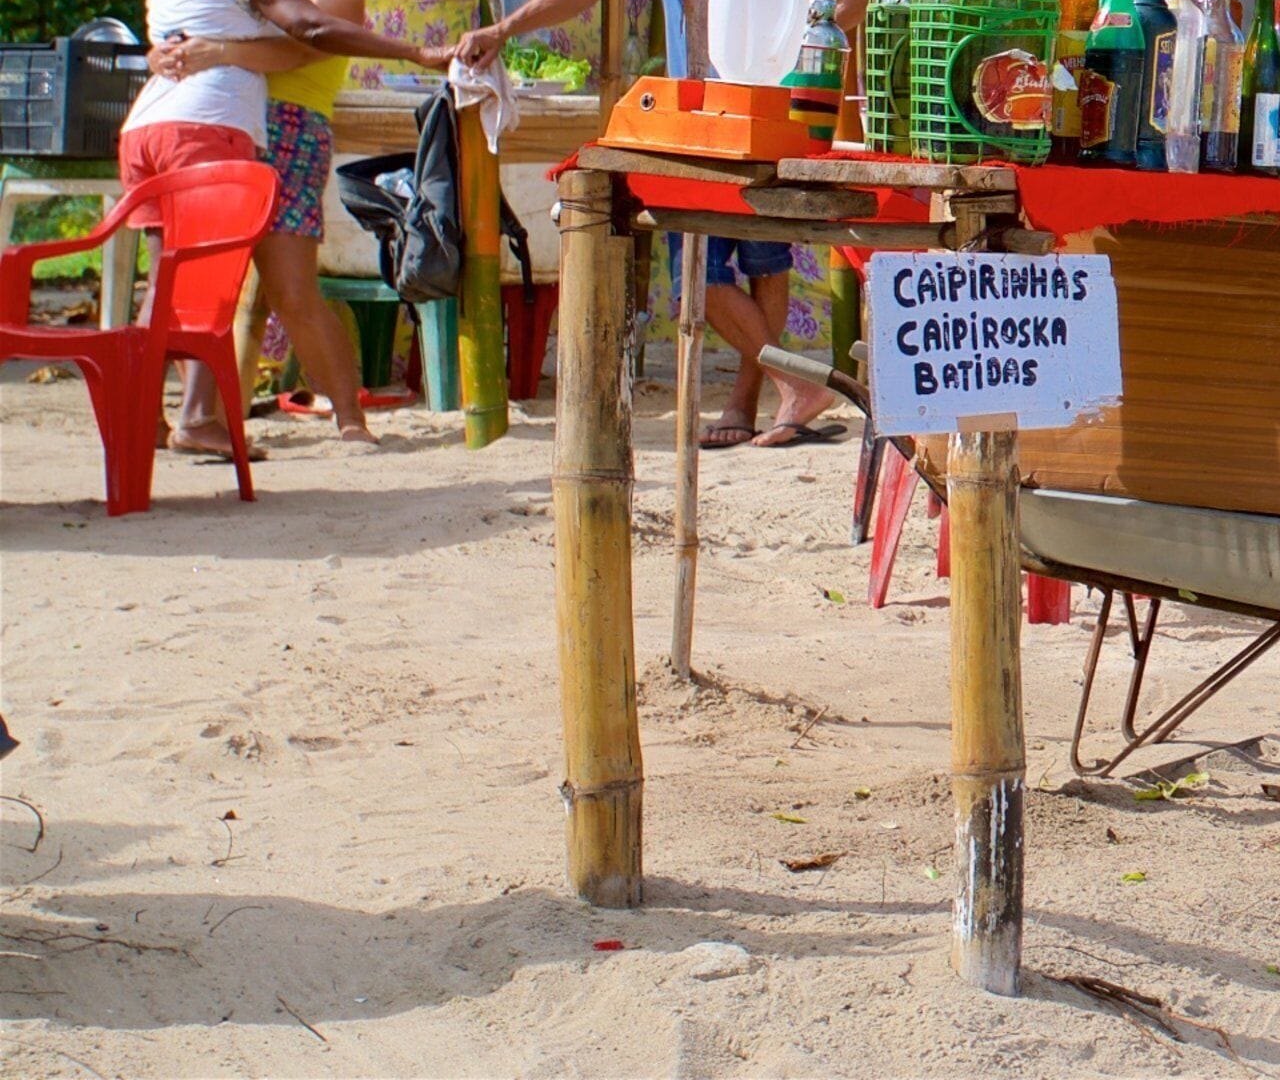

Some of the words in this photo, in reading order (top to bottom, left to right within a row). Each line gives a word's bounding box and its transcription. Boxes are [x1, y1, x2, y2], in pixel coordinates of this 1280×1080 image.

[893, 260, 1089, 308] CAIPIRINHAS
[897, 311, 1068, 356] CAIPIROSKA
[914, 353, 1039, 395] BATIDAS
